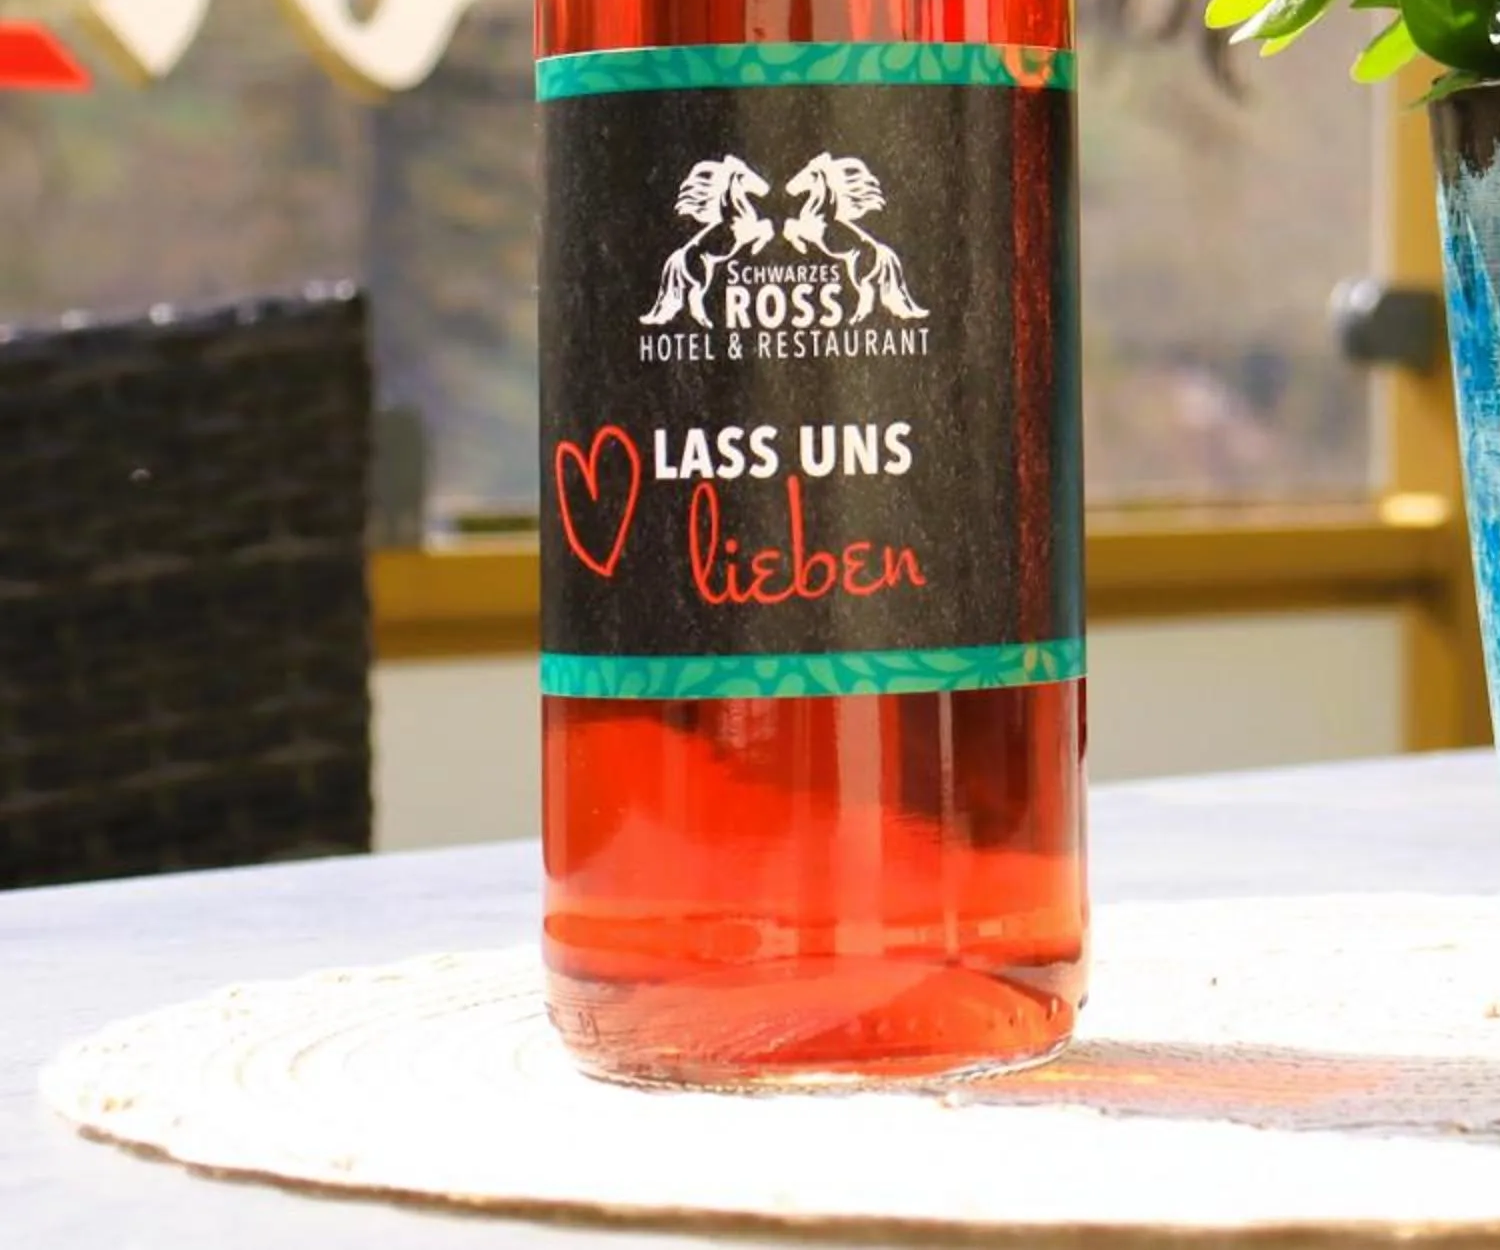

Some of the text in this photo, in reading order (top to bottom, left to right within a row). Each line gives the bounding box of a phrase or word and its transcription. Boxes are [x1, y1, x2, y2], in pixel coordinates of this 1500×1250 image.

[725, 283, 844, 330] ROSS
[639, 327, 930, 362] HOTEL & RESTAURANT
[654, 421, 913, 480] LASS UNS
[688, 473, 927, 606] lieben
